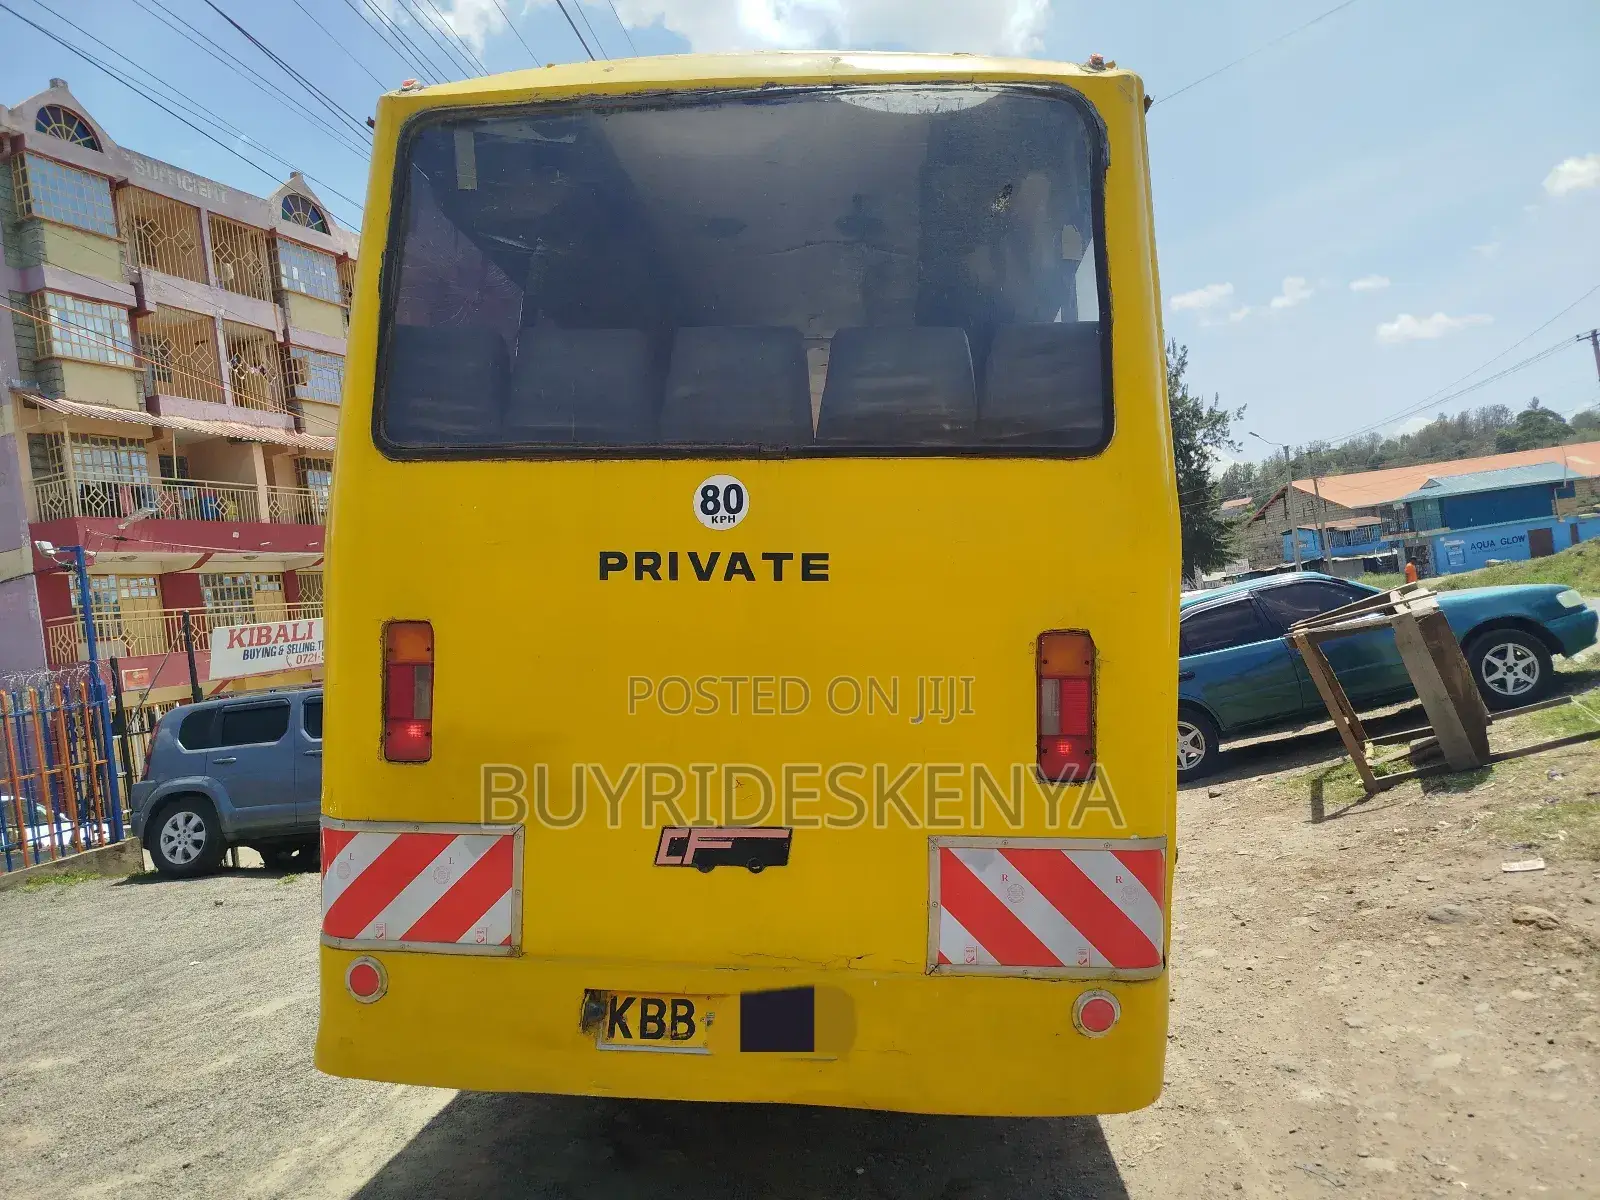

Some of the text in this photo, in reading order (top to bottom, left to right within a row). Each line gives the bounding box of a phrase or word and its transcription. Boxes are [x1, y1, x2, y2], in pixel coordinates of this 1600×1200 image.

[700, 484, 744, 516] 80
[711, 515, 736, 524] KPH
[1470, 540, 1496, 551] AQUA
[1500, 534, 1526, 547] GLOW
[599, 551, 830, 582] PRIVATE
[226, 621, 315, 650] KIBALI
[242, 645, 277, 661] BUYING
[278, 645, 284, 656] &
[1001, 873, 1009, 882] R
[1115, 875, 1123, 884] R
[607, 996, 696, 1041] KBB
